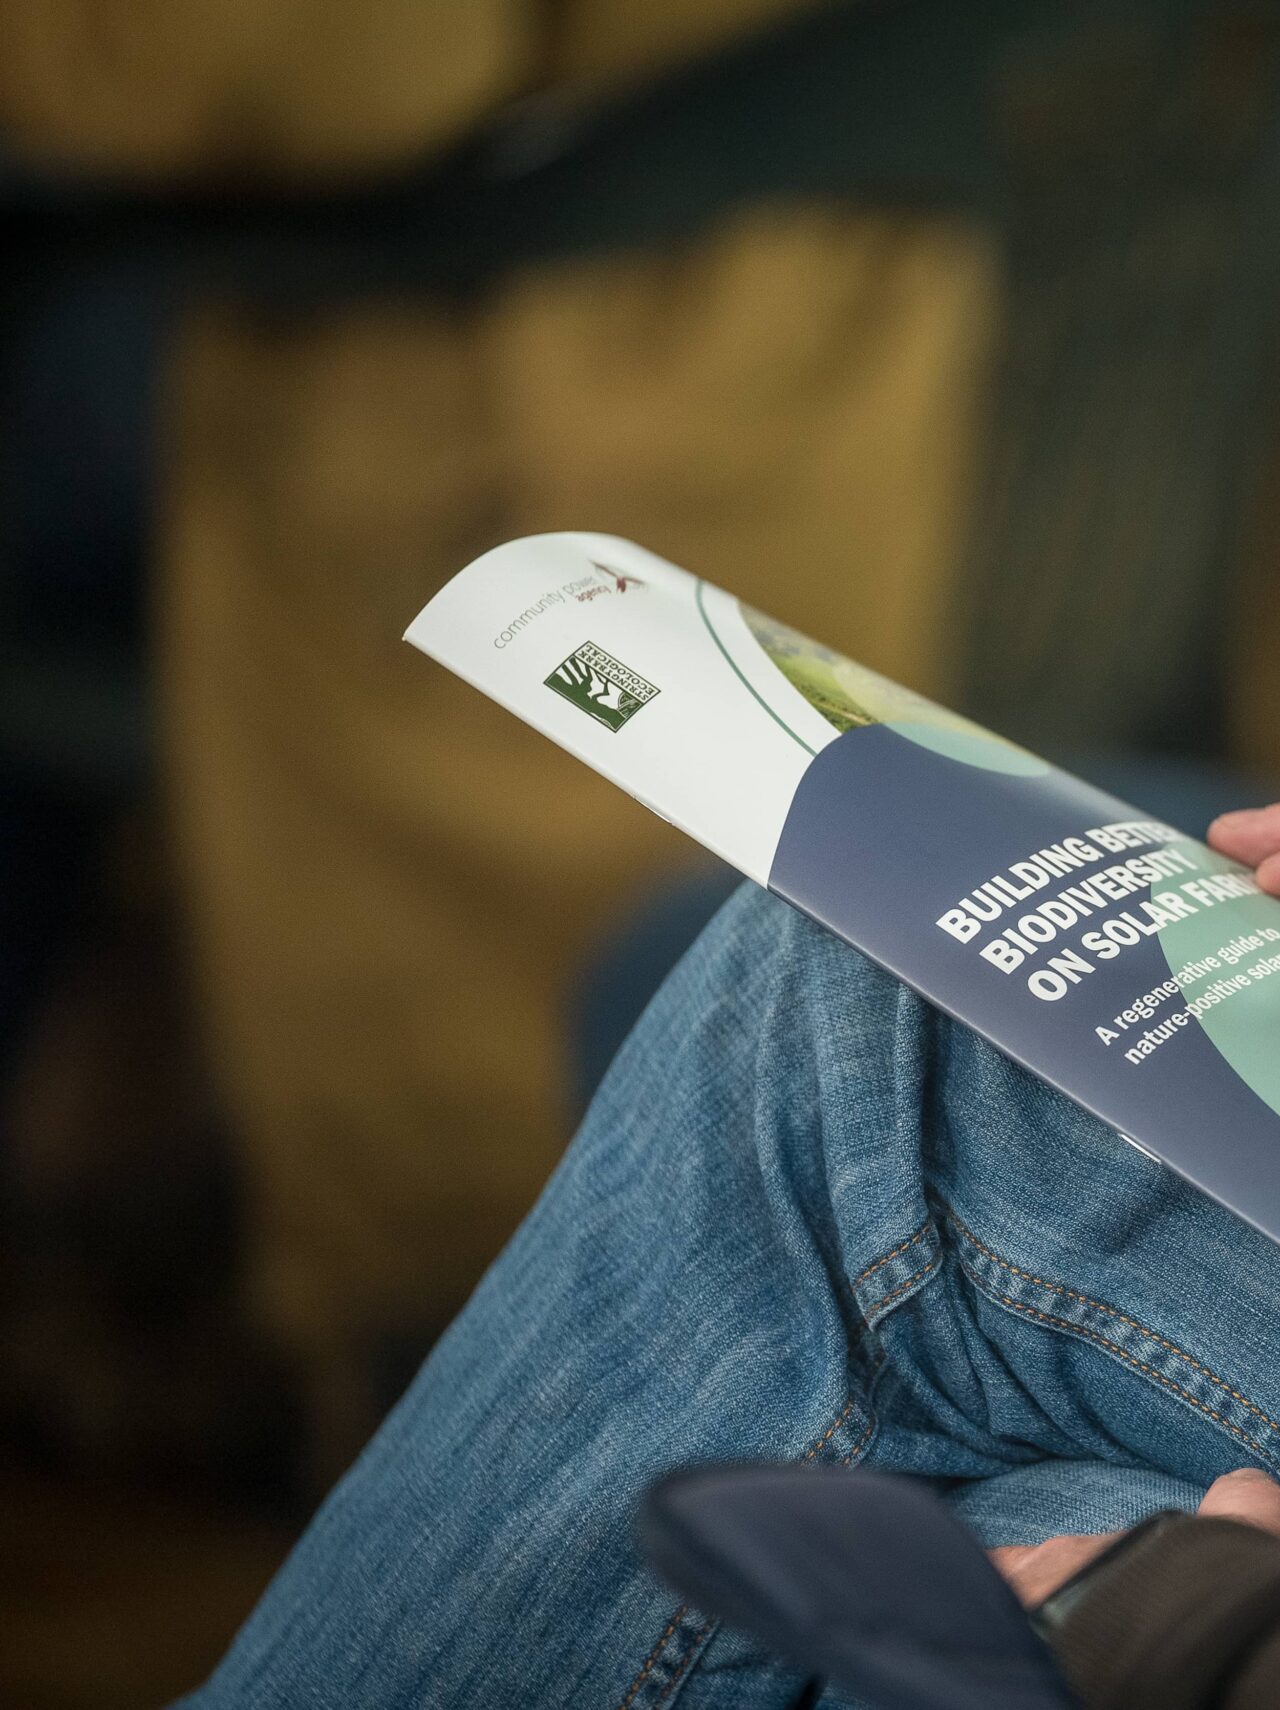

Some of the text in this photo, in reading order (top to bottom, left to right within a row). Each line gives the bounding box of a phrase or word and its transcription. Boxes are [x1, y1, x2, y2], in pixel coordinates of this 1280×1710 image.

[494, 589, 565, 649] community
[578, 650, 649, 701] STRINGYBARK
[585, 644, 656, 696] ECOLOGICAL
[936, 837, 1104, 944] BUILDING
[979, 849, 1198, 975] BIODIVERSITY
[1027, 948, 1096, 1001] ON
[1081, 892, 1199, 960] SOLAR
[1095, 1025, 1119, 1046] A
[1113, 954, 1222, 1030] regenerative
[1217, 932, 1258, 965] guide
[1124, 972, 1252, 1065] nature-positive
